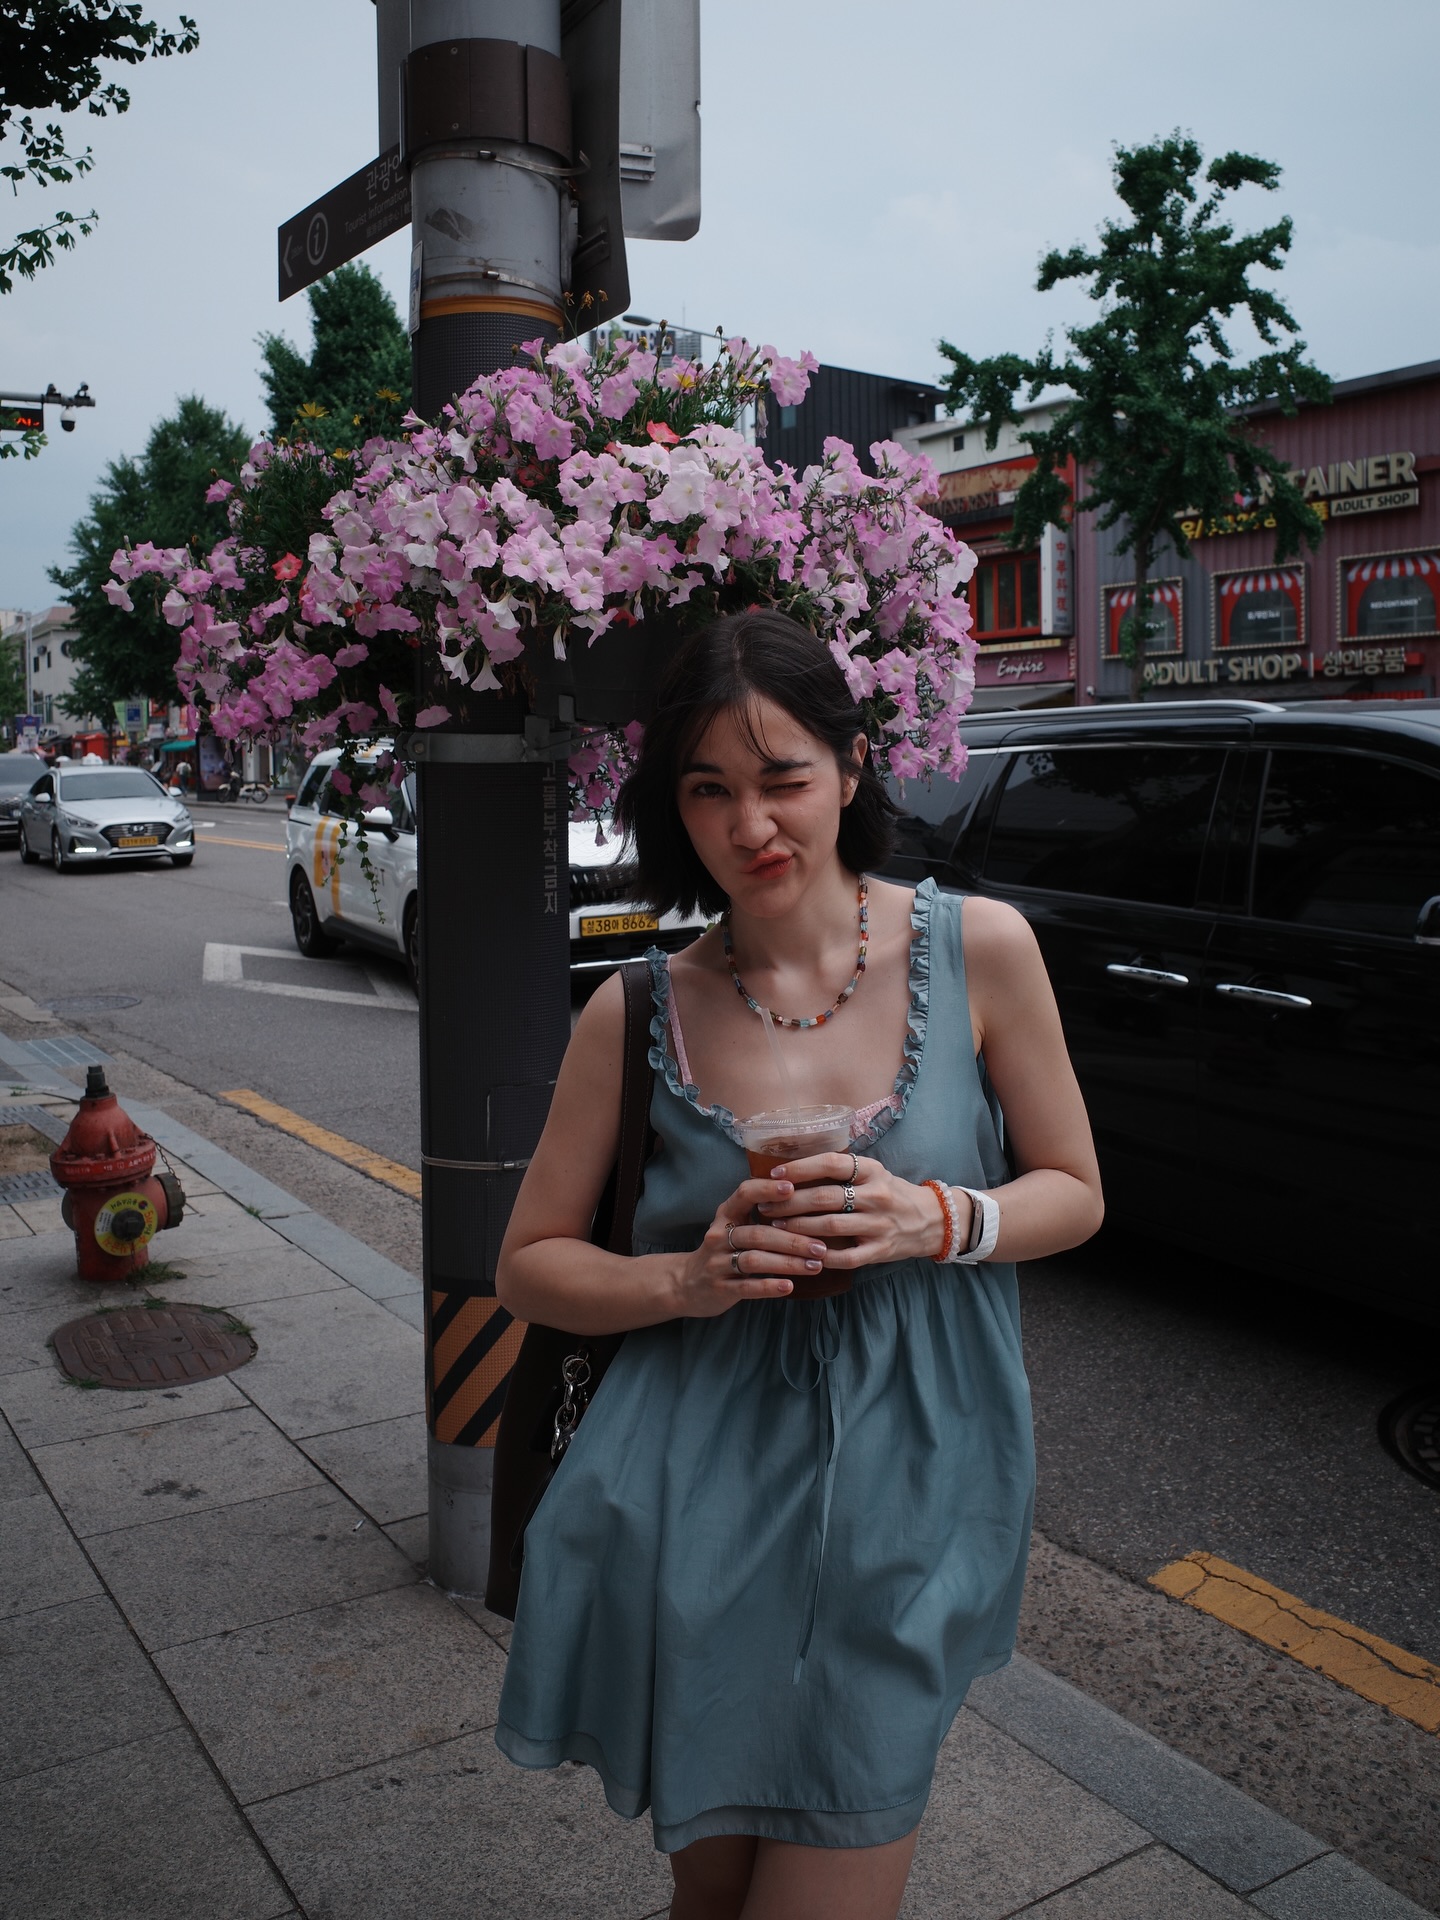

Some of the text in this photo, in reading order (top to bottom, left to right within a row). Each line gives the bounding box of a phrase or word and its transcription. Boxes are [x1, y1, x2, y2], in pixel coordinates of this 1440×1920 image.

[368, 187, 408, 219] Information
[1335, 498, 1374, 513] ADULT
[1377, 492, 1410, 507] SHOP
[997, 656, 1045, 679] Empire
[1143, 646, 1406, 685] ADULT SHOP 성인용품
